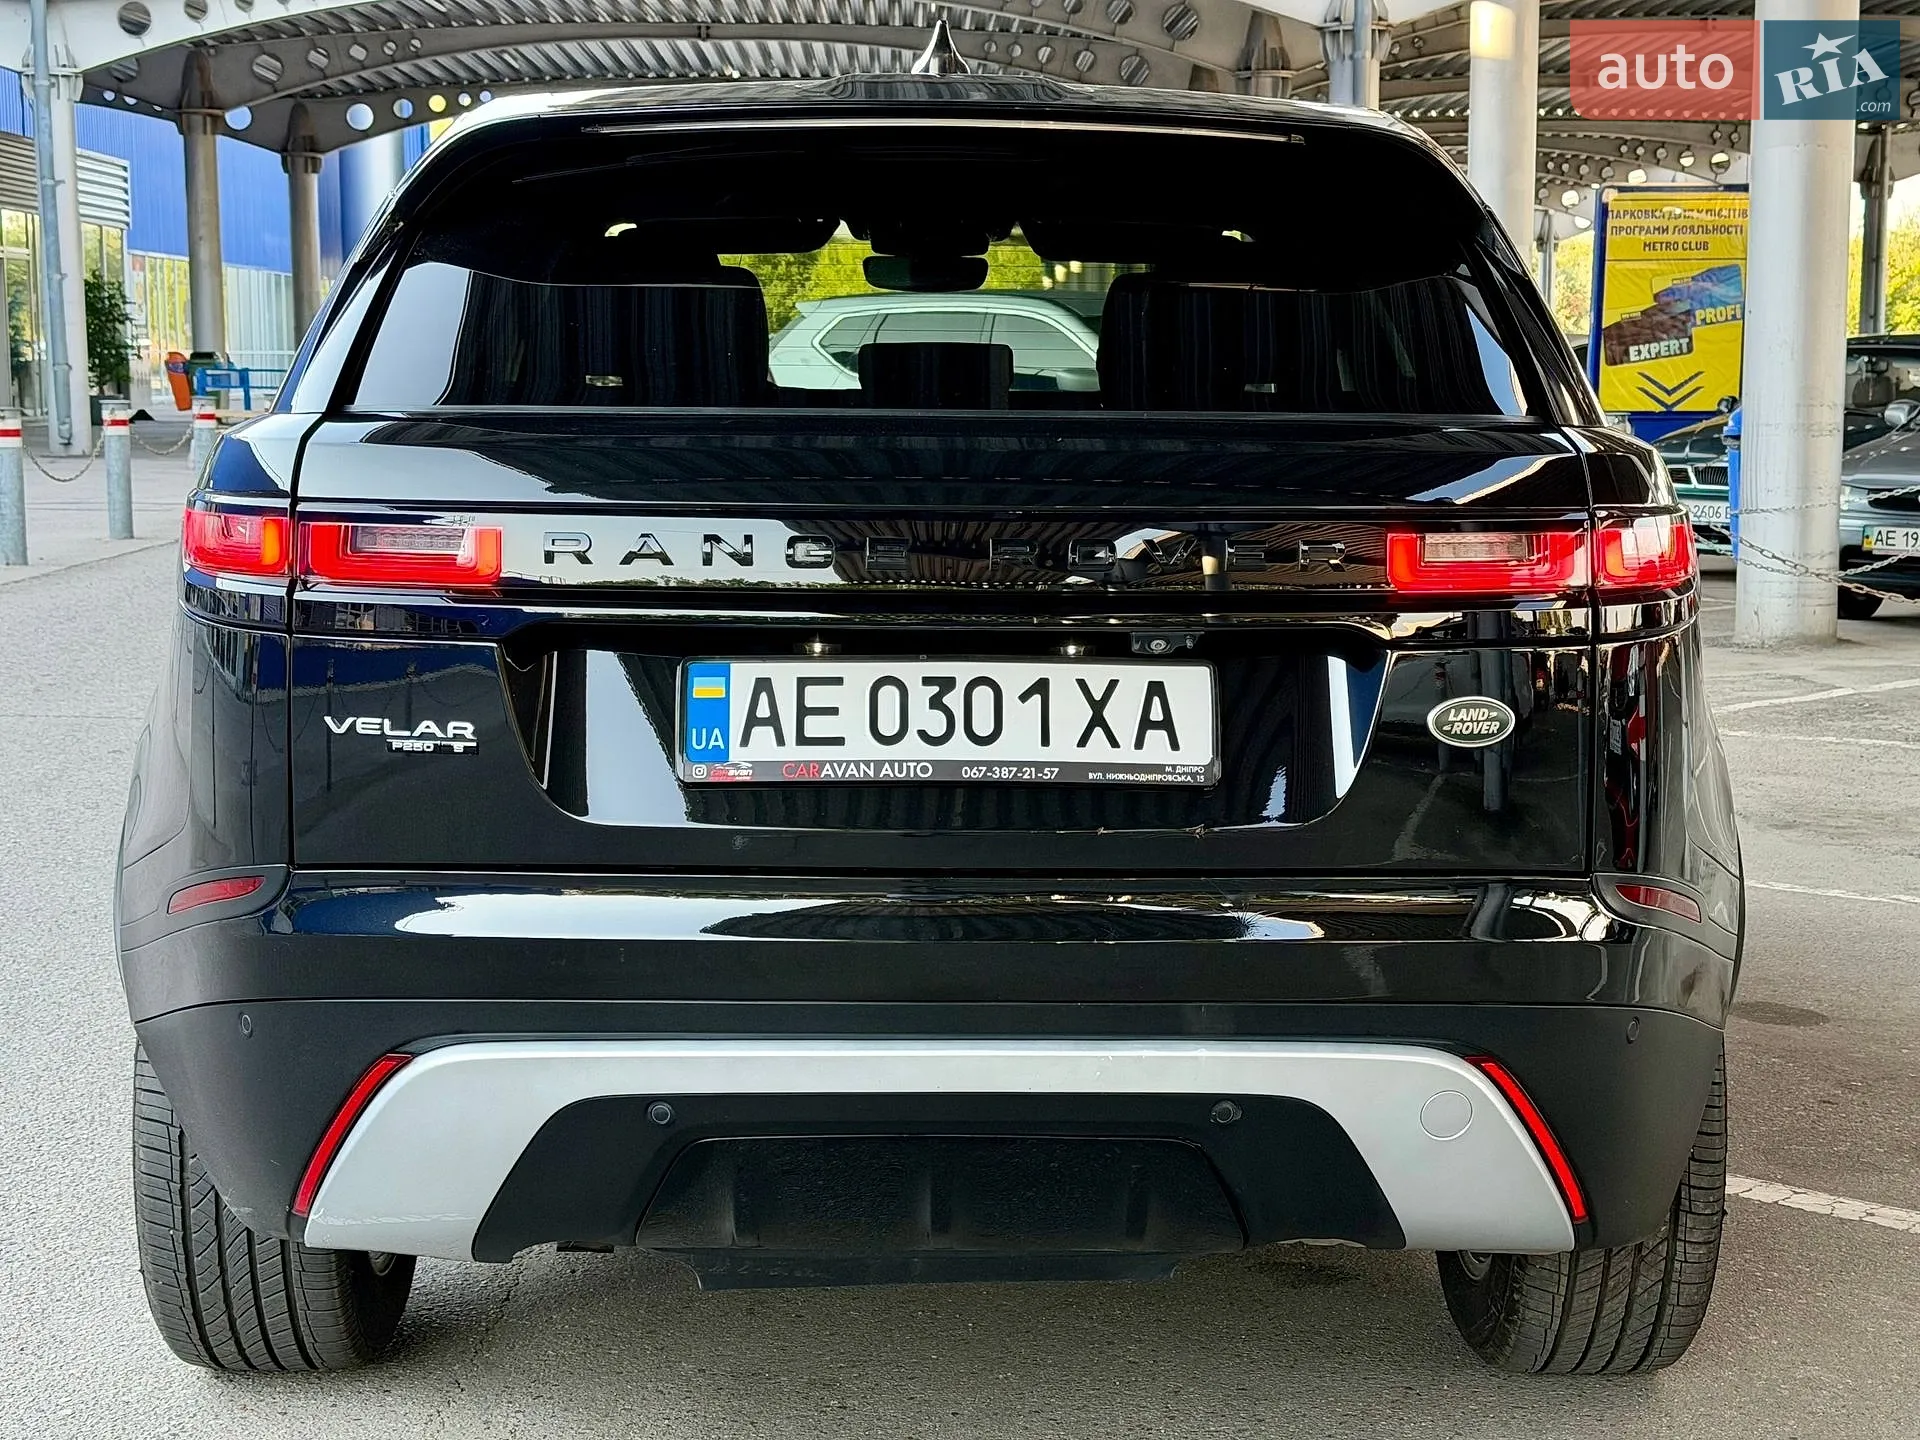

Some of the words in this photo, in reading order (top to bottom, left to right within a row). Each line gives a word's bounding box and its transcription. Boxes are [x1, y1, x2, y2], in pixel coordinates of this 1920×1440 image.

[1610, 225, 1669, 236] ПРОГРАМИ
[1671, 224, 1744, 236] ЛОЯЛЬНОСТІ
[1643, 241, 1679, 252] METRO
[1681, 241, 1709, 251] CLUB
[1695, 303, 1742, 325] PROFI
[1628, 337, 1690, 362] EXPERT
[1873, 529, 1897, 547] AE
[543, 531, 910, 571] RANGE
[989, 537, 1347, 573] ROVER
[739, 676, 846, 748] AE
[868, 675, 1051, 748] 0301
[1075, 678, 1181, 752] XA
[1448, 708, 1489, 722] LAND
[323, 715, 478, 740] VELAR
[1450, 721, 1501, 735] ROVER
[691, 728, 725, 750] UA
[392, 742, 435, 752] P250
[782, 762, 874, 778] CARAVAN
[879, 762, 933, 778] AUTO
[961, 766, 1060, 780] 067-387-21-57
[1088, 772, 1104, 780] ВУЛ.
[1176, 766, 1205, 774] ДНІПРО
